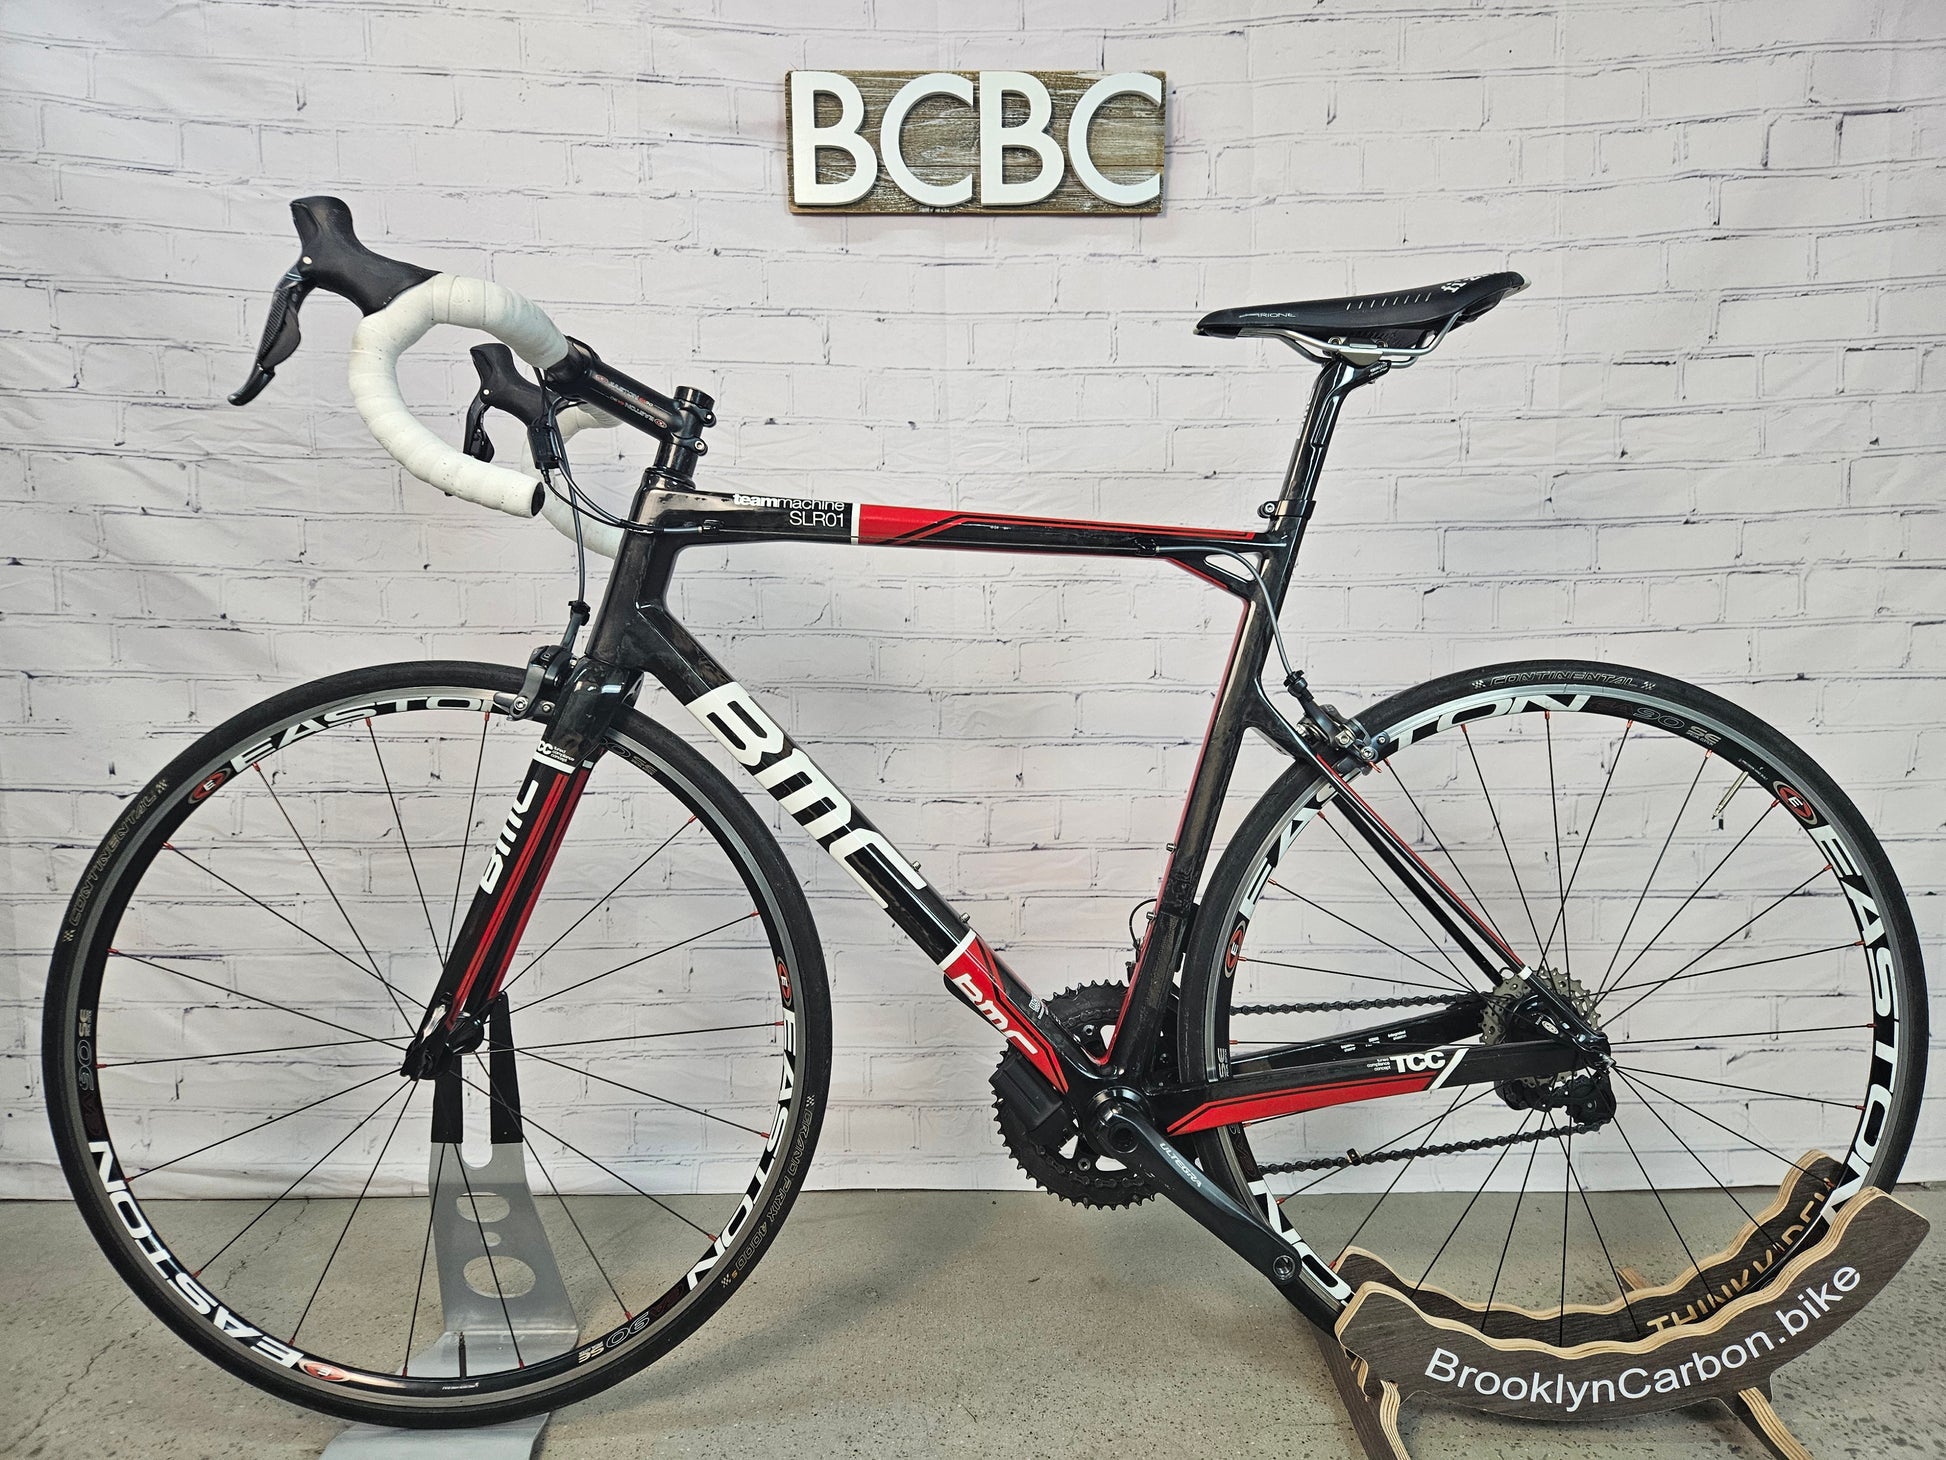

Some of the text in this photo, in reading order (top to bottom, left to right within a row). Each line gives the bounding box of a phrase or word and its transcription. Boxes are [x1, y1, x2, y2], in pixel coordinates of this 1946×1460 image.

[791, 71, 1162, 207] BCBC
[733, 493, 845, 511] teammachine
[789, 511, 844, 527] SLR01
[1489, 671, 1639, 687] CONTINENTAL
[685, 681, 927, 908] BMC
[69, 793, 156, 926] CONTINENTAL
[1389, 1051, 1446, 1073] TCC
[687, 1008, 796, 1291] EASTON
[787, 1110, 813, 1177] GRAND
[1160, 1142, 1202, 1188] ULTEGRA
[766, 1175, 792, 1223] PRIX
[88, 1141, 304, 1368] EASTON
[735, 1221, 769, 1270] 4000
[1424, 1267, 1860, 1411] BrooklynCarbon.bike
